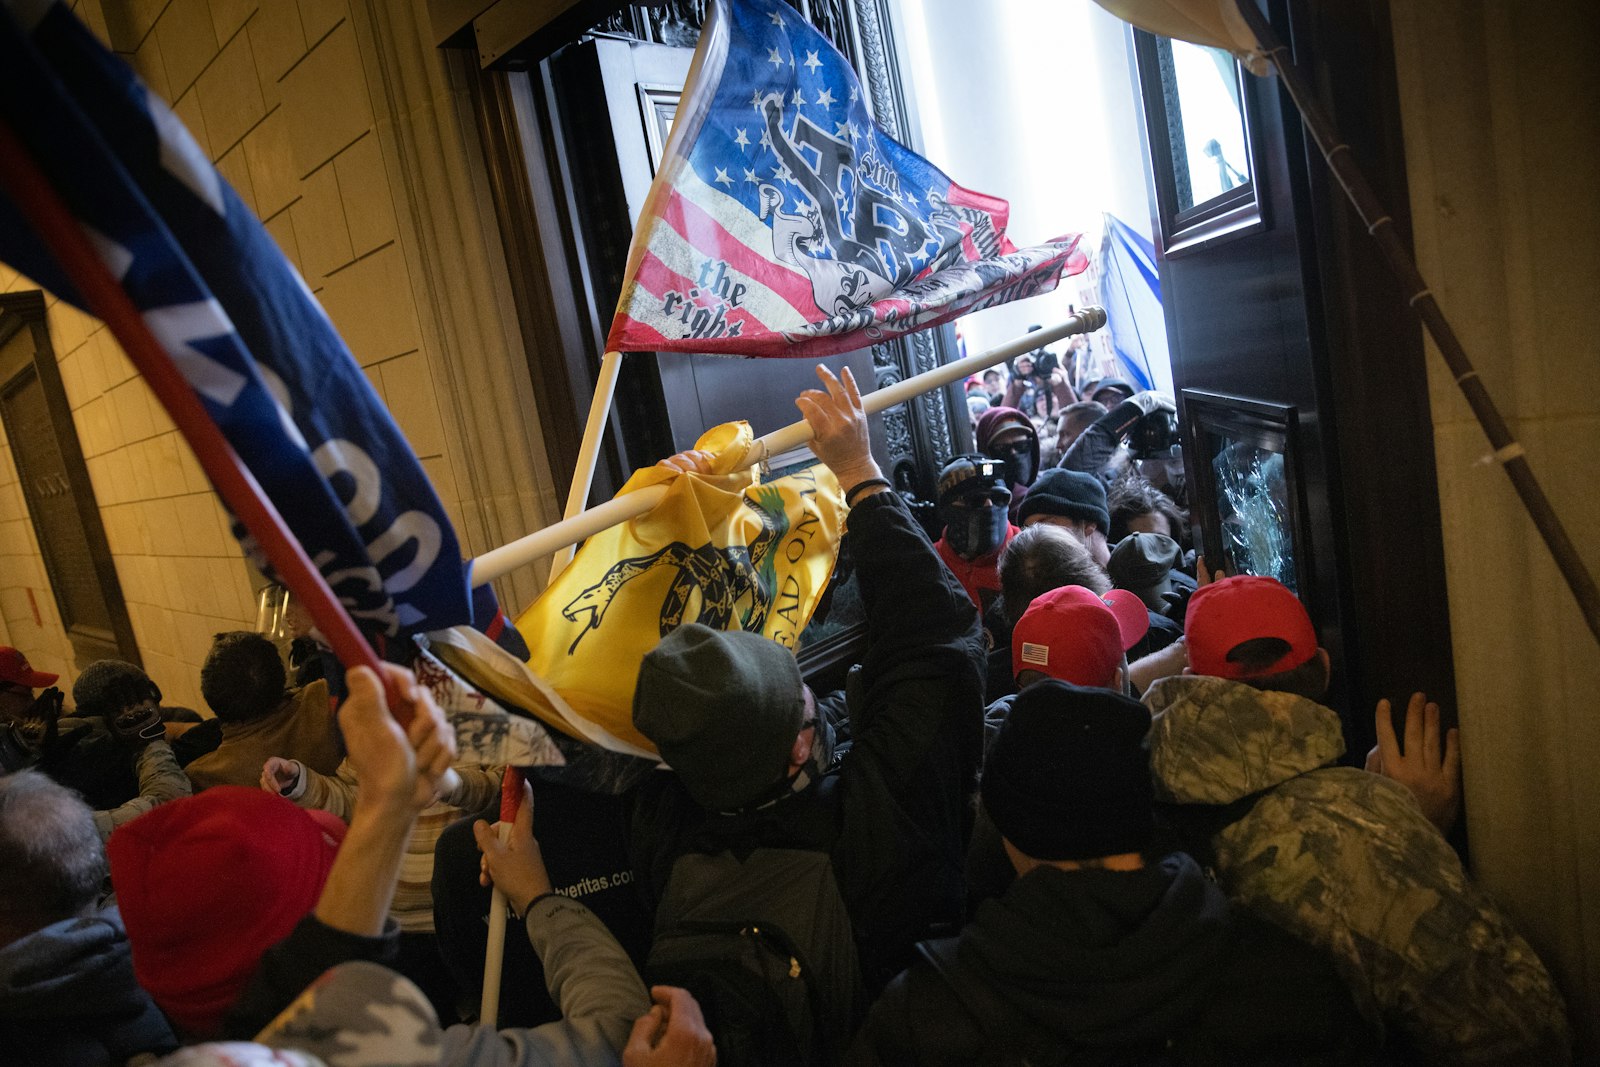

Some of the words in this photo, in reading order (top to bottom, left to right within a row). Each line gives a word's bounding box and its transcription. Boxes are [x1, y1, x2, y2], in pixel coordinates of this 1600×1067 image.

[696, 258, 748, 308] the
[662, 289, 744, 339] right
[785, 508, 821, 565] ON
[773, 573, 801, 652] EAD
